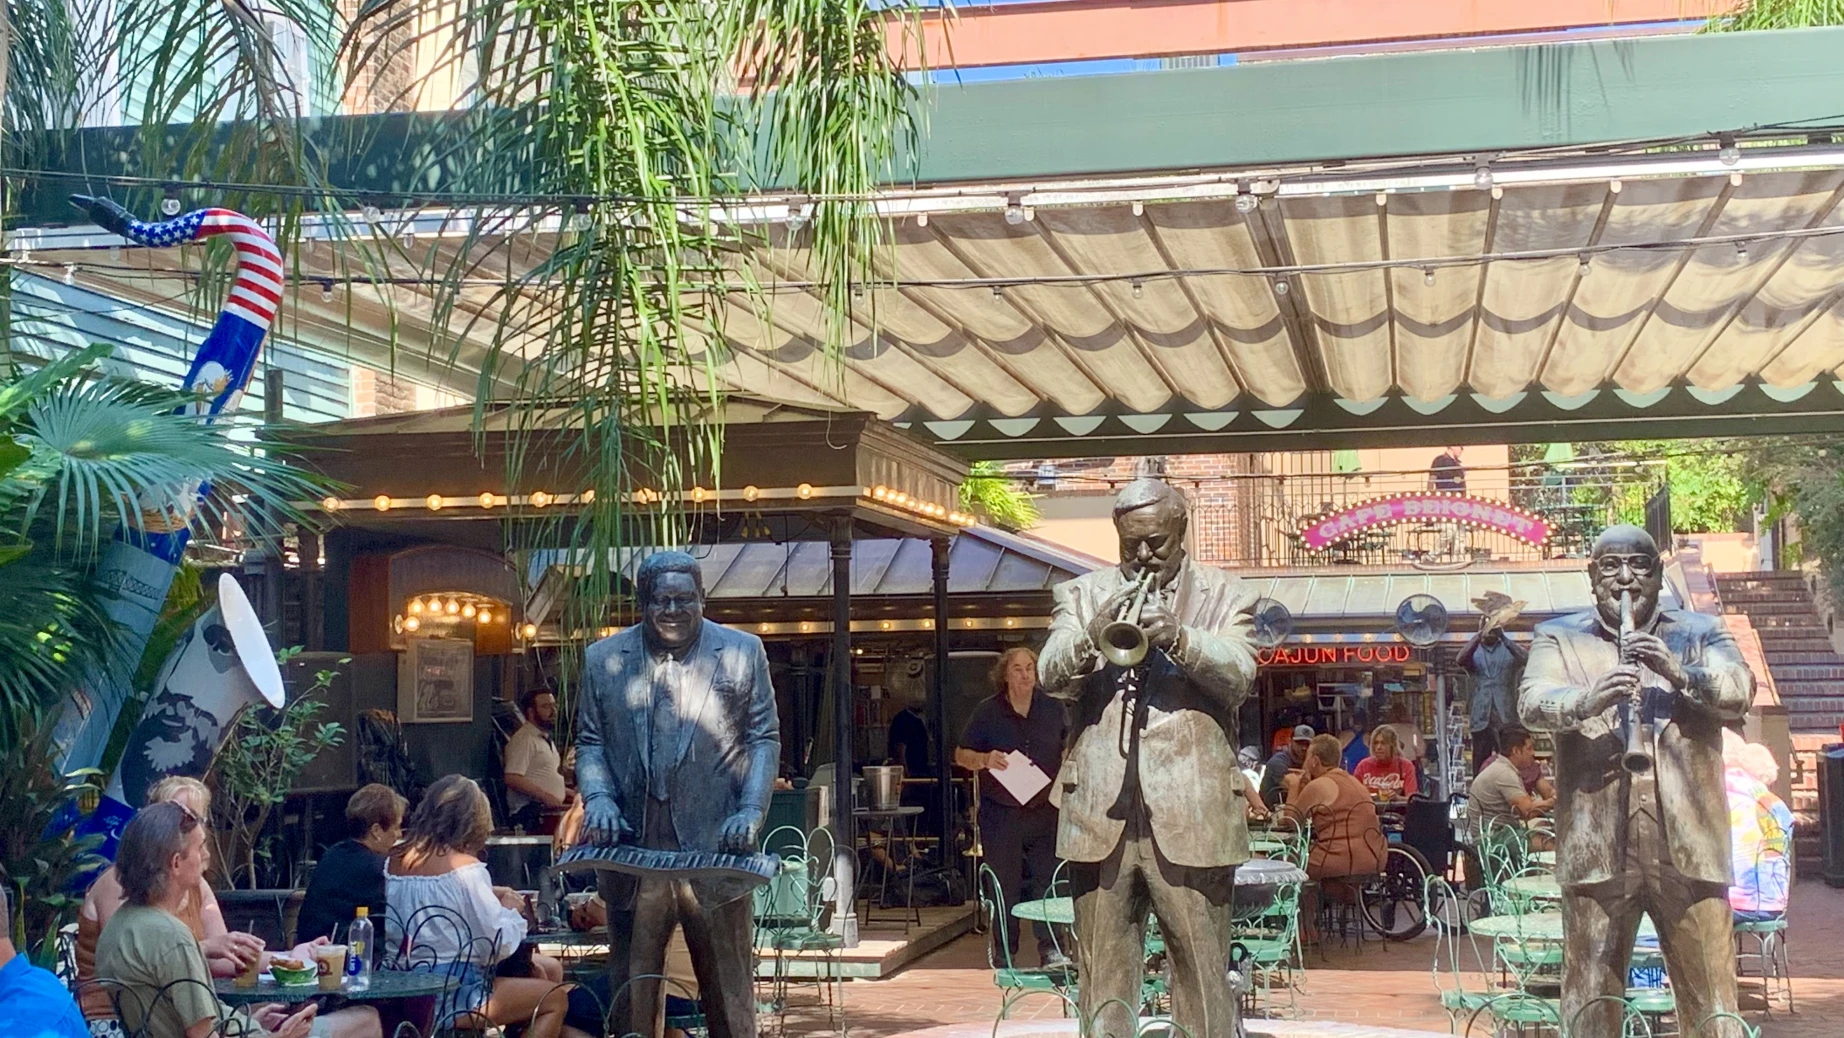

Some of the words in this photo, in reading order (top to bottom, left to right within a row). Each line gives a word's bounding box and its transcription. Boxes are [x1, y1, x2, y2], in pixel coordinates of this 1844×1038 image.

[1404, 500, 1533, 532] BEIGNET
[1258, 646, 1336, 666] CAJUN
[1343, 645, 1410, 662] FOOD
